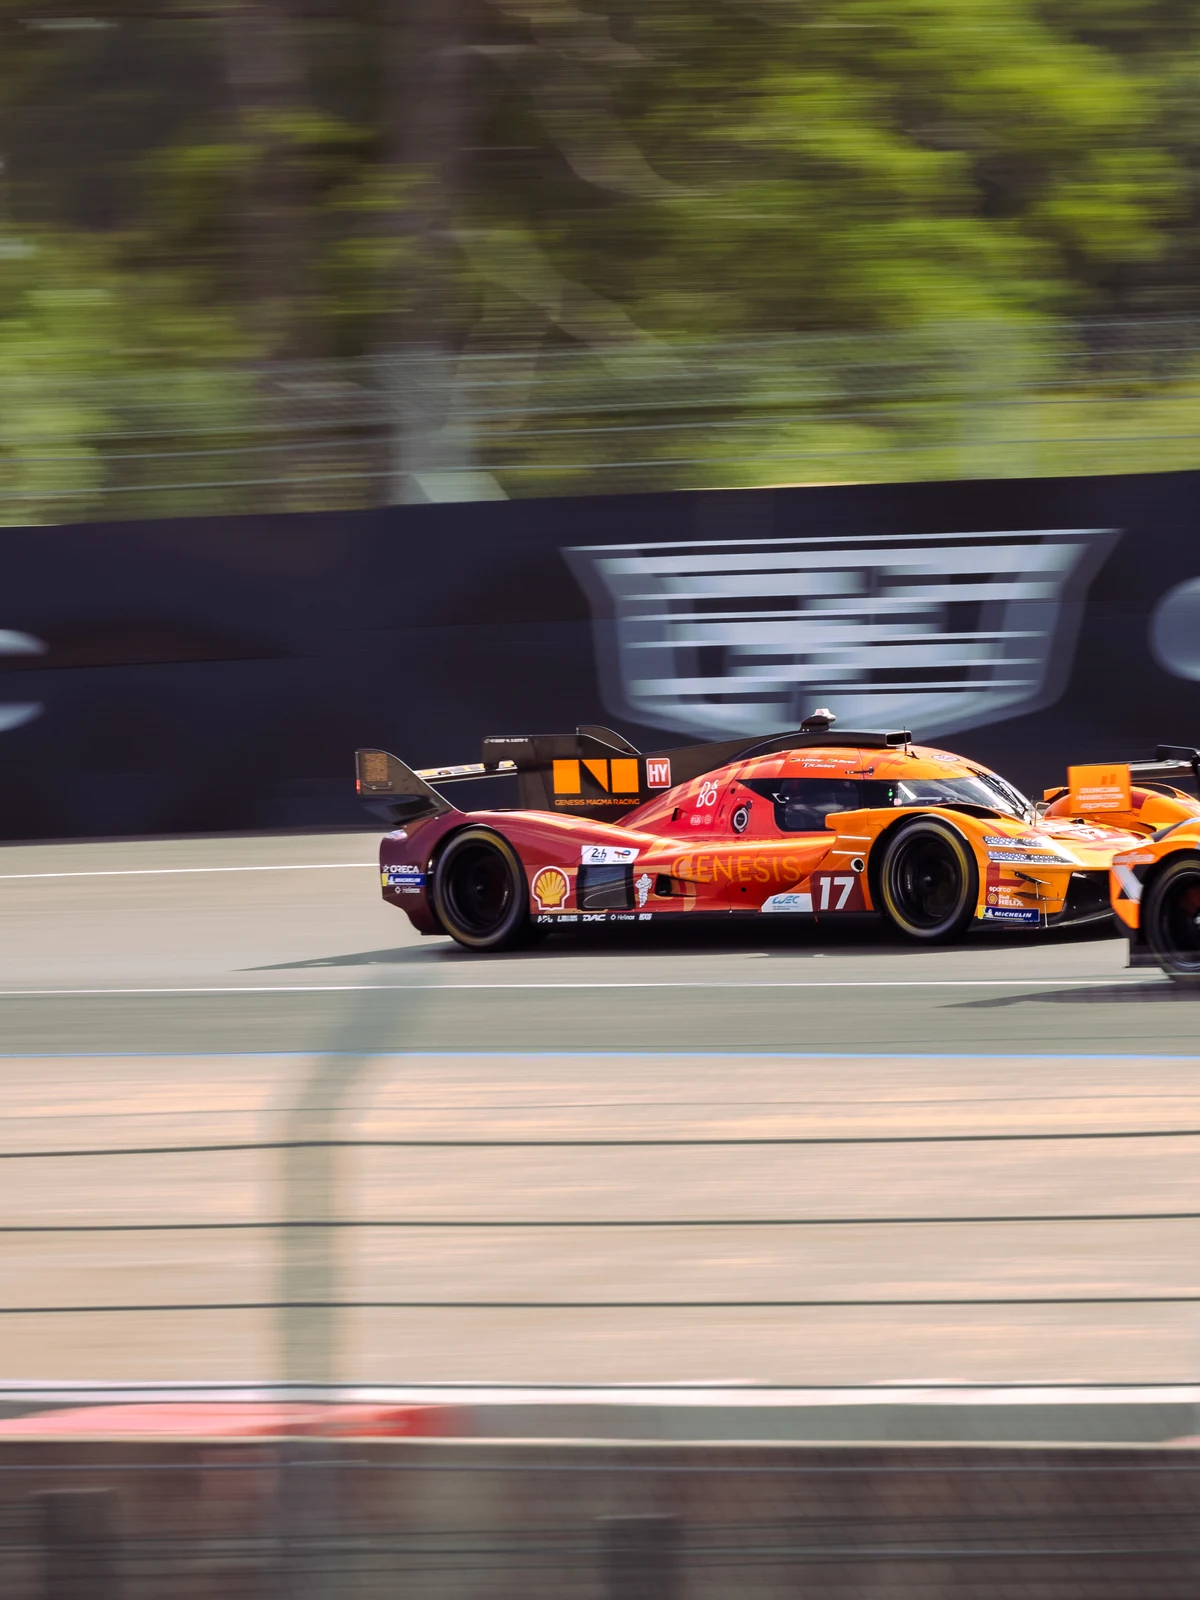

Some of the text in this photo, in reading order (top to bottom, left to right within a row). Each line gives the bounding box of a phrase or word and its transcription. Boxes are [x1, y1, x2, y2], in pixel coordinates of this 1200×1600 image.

[649, 764, 668, 783] HY
[389, 865, 420, 873] ORECA
[671, 855, 801, 883] GENESIS
[819, 876, 855, 910] 17
